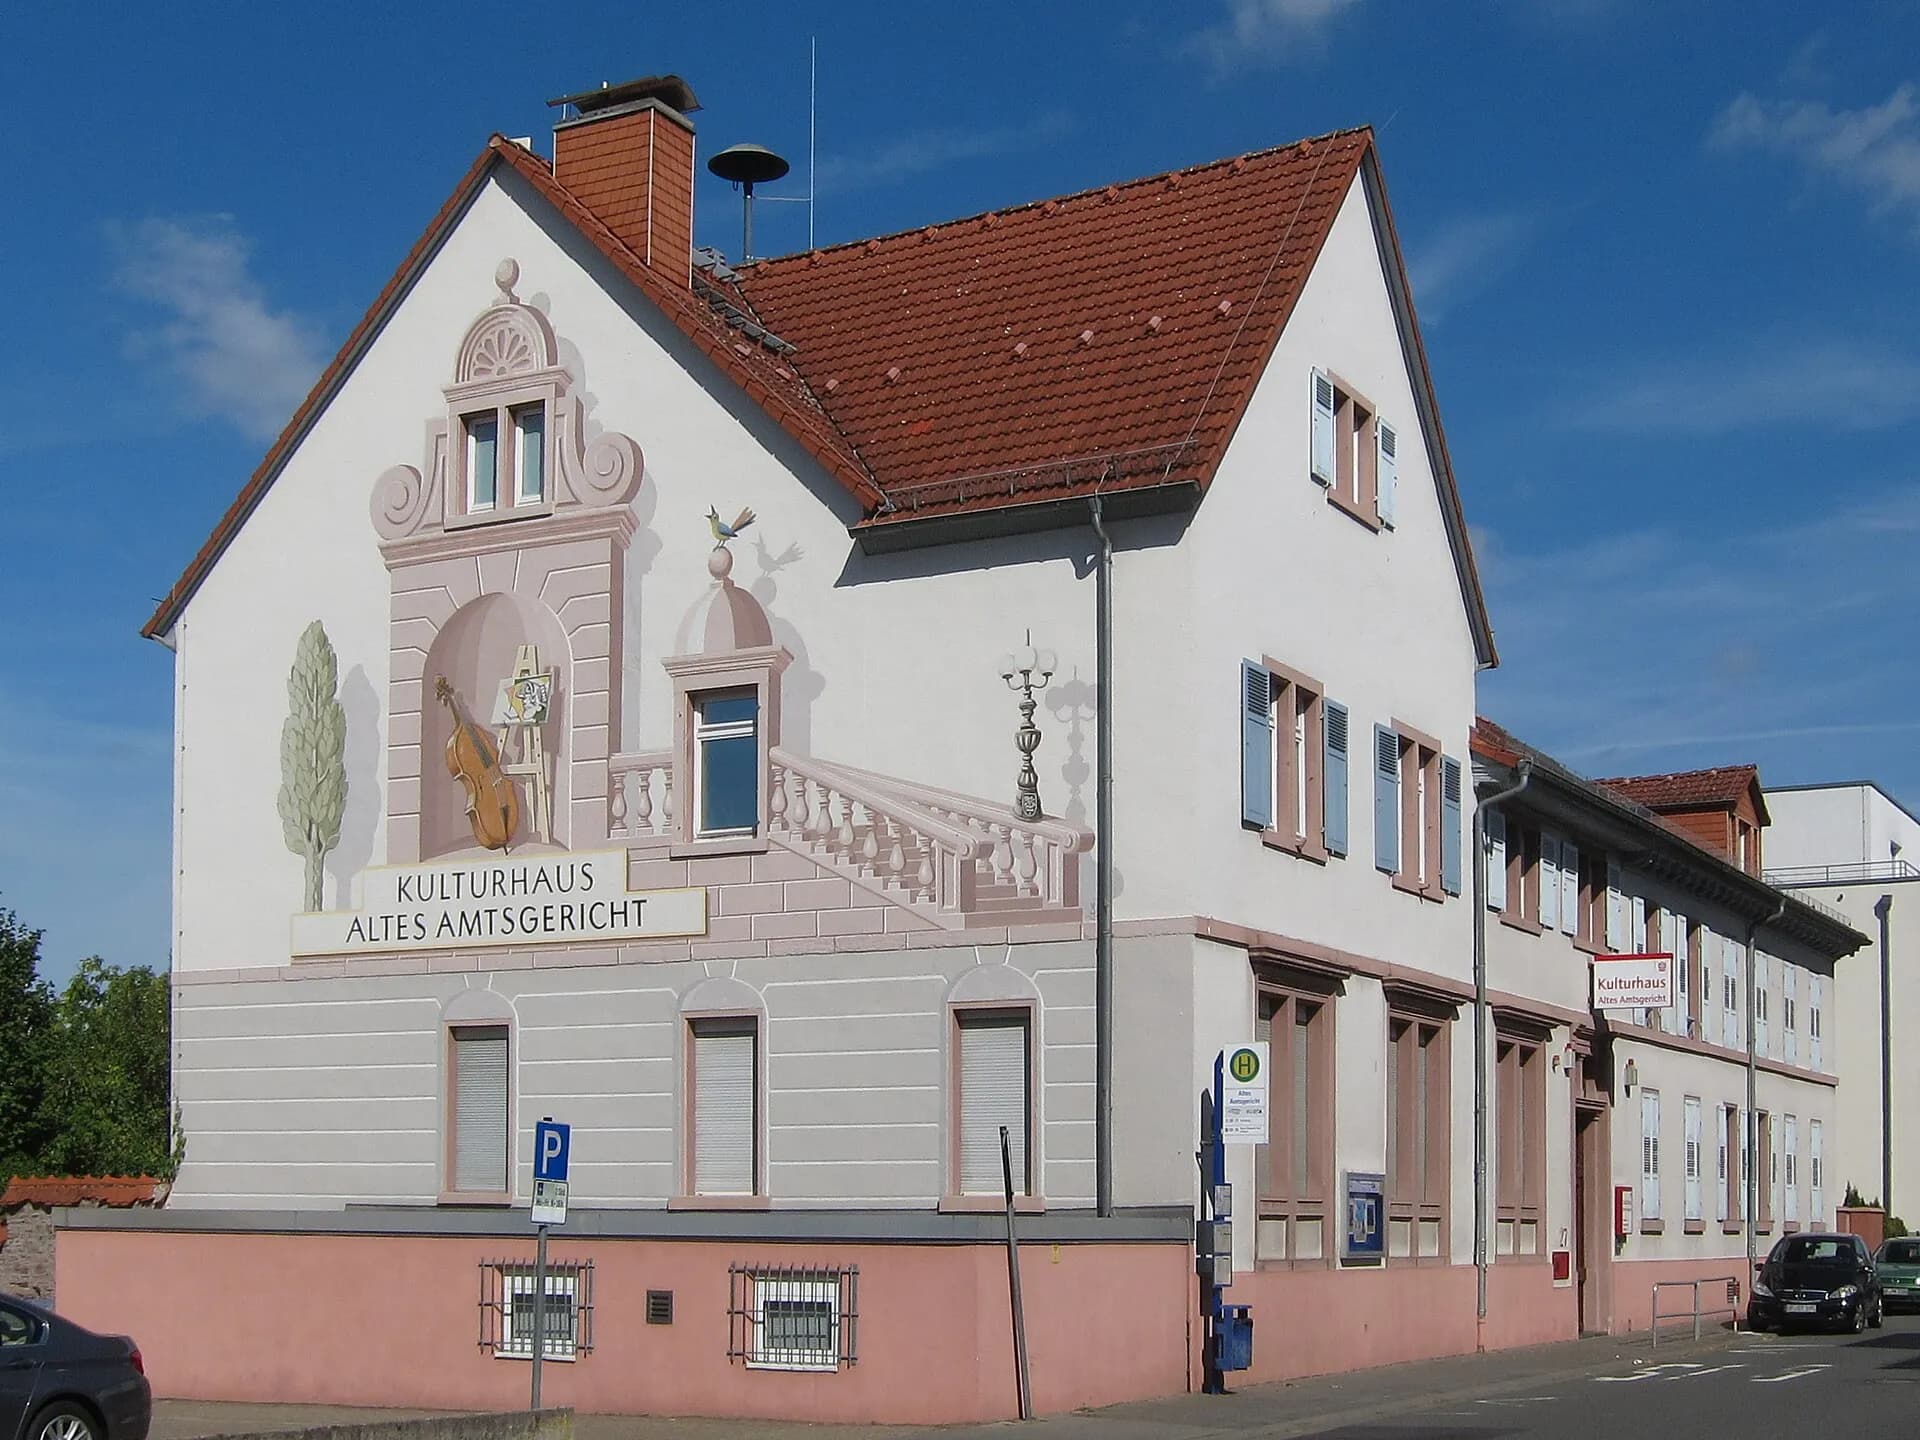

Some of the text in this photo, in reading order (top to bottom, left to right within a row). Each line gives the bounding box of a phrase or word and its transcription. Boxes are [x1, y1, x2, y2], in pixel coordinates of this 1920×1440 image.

[398, 862, 594, 903] KULTURHAUS
[345, 899, 649, 943] ALTES AMTSGERICHT
[1598, 976, 1666, 990] Kulturhaus
[1598, 994, 1666, 1005] Altes Amtsgericht
[1238, 1055, 1251, 1075] H
[541, 1130, 562, 1174] P
